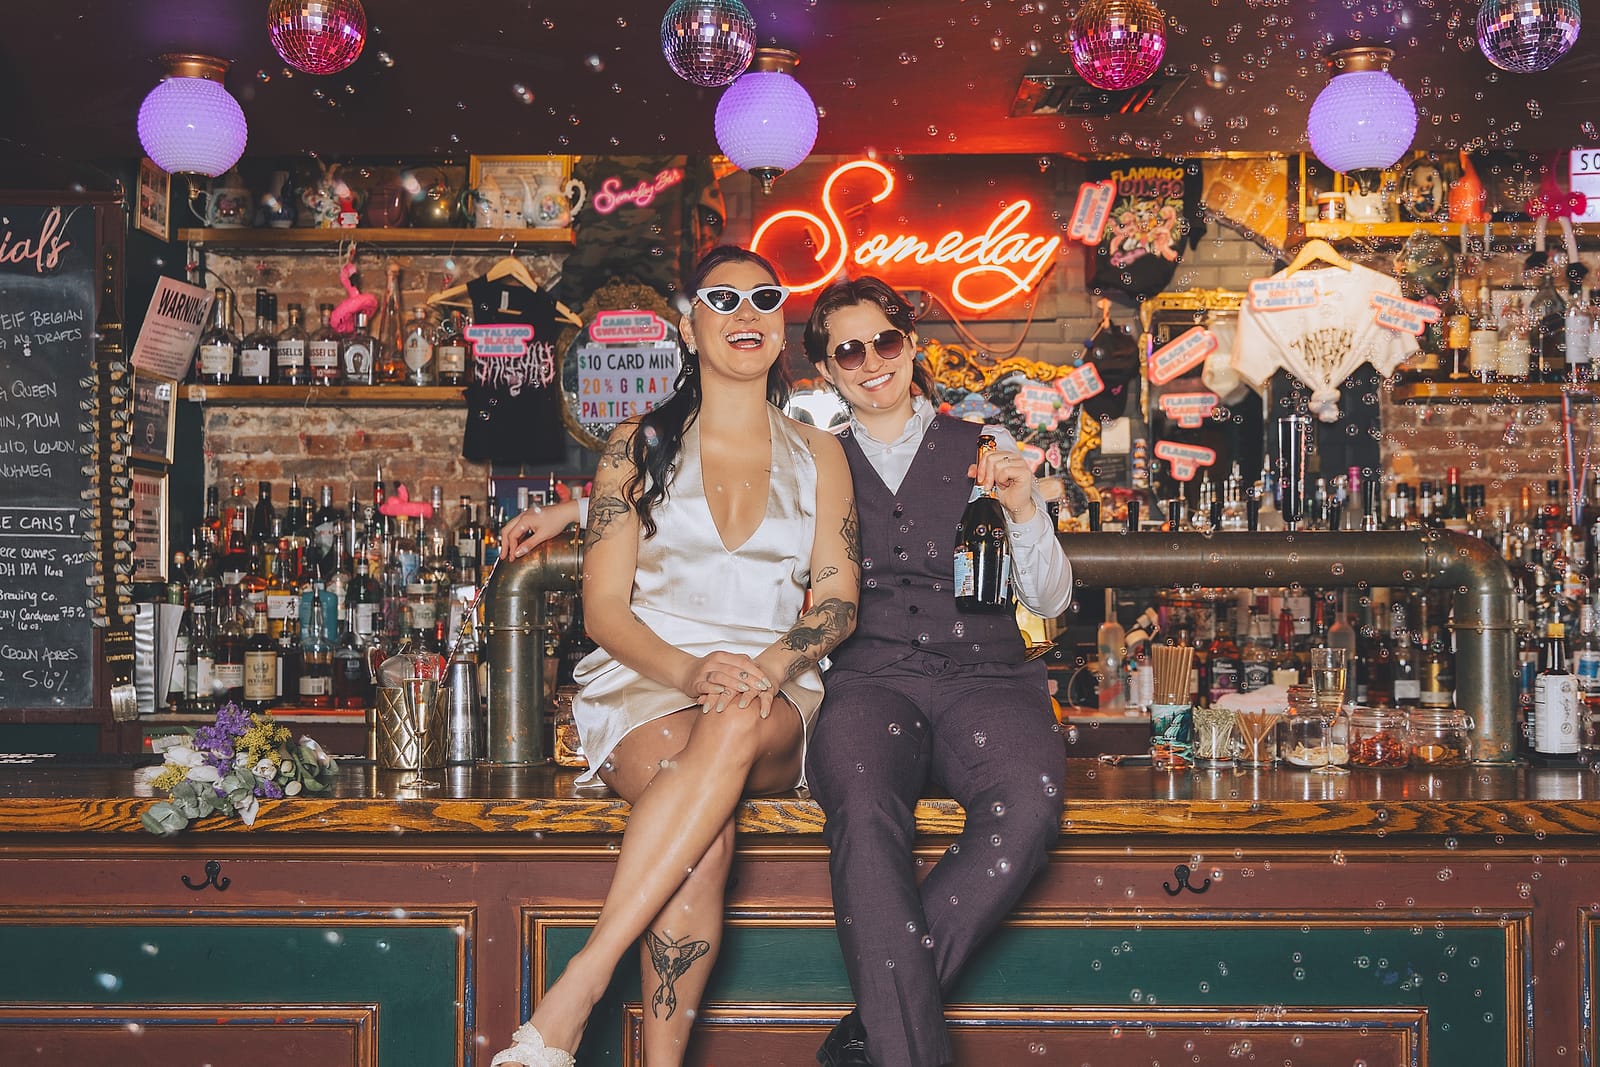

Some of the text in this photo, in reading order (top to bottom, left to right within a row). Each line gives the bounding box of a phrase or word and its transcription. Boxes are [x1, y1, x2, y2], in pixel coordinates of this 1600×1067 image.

[1111, 167, 1184, 181] FLAMINGO
[751, 160, 1060, 310] Someday
[157, 288, 207, 326] WARNING
[30, 309, 82, 327] BELGIAN
[34, 328, 82, 345] DRAFTS
[469, 328, 530, 337] METAL LOGO
[579, 353, 675, 371] $10 CARD MIN
[12, 380, 57, 398] QUEEN
[583, 377, 613, 396] 20%
[582, 401, 638, 418] PARTIES
[20, 562, 38, 576] IPA
[0, 589, 37, 607] Brewing
